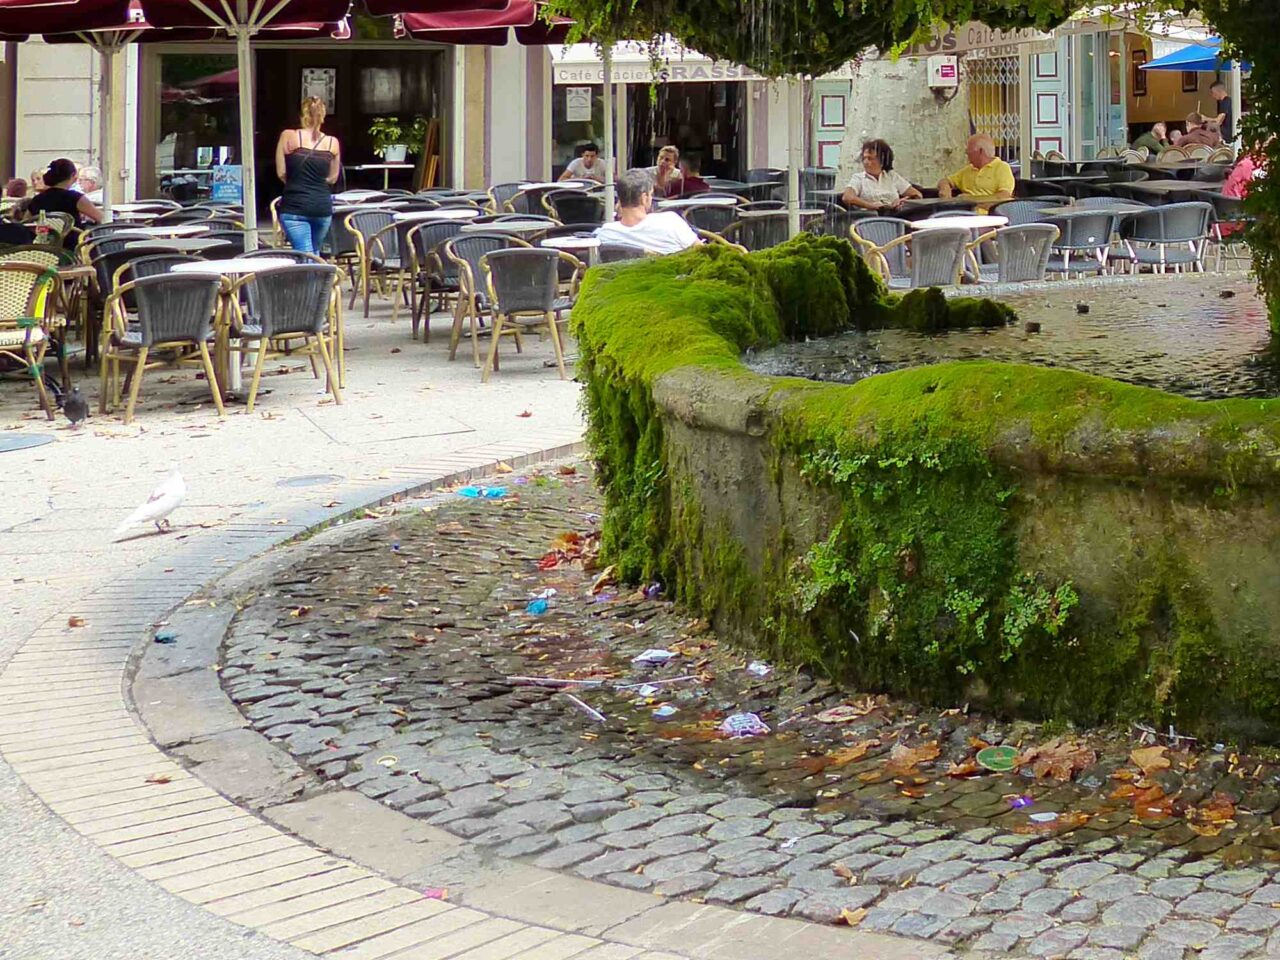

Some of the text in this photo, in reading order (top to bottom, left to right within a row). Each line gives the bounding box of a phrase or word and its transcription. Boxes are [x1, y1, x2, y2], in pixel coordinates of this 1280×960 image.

[559, 64, 746, 81] Café Gacier RASS
